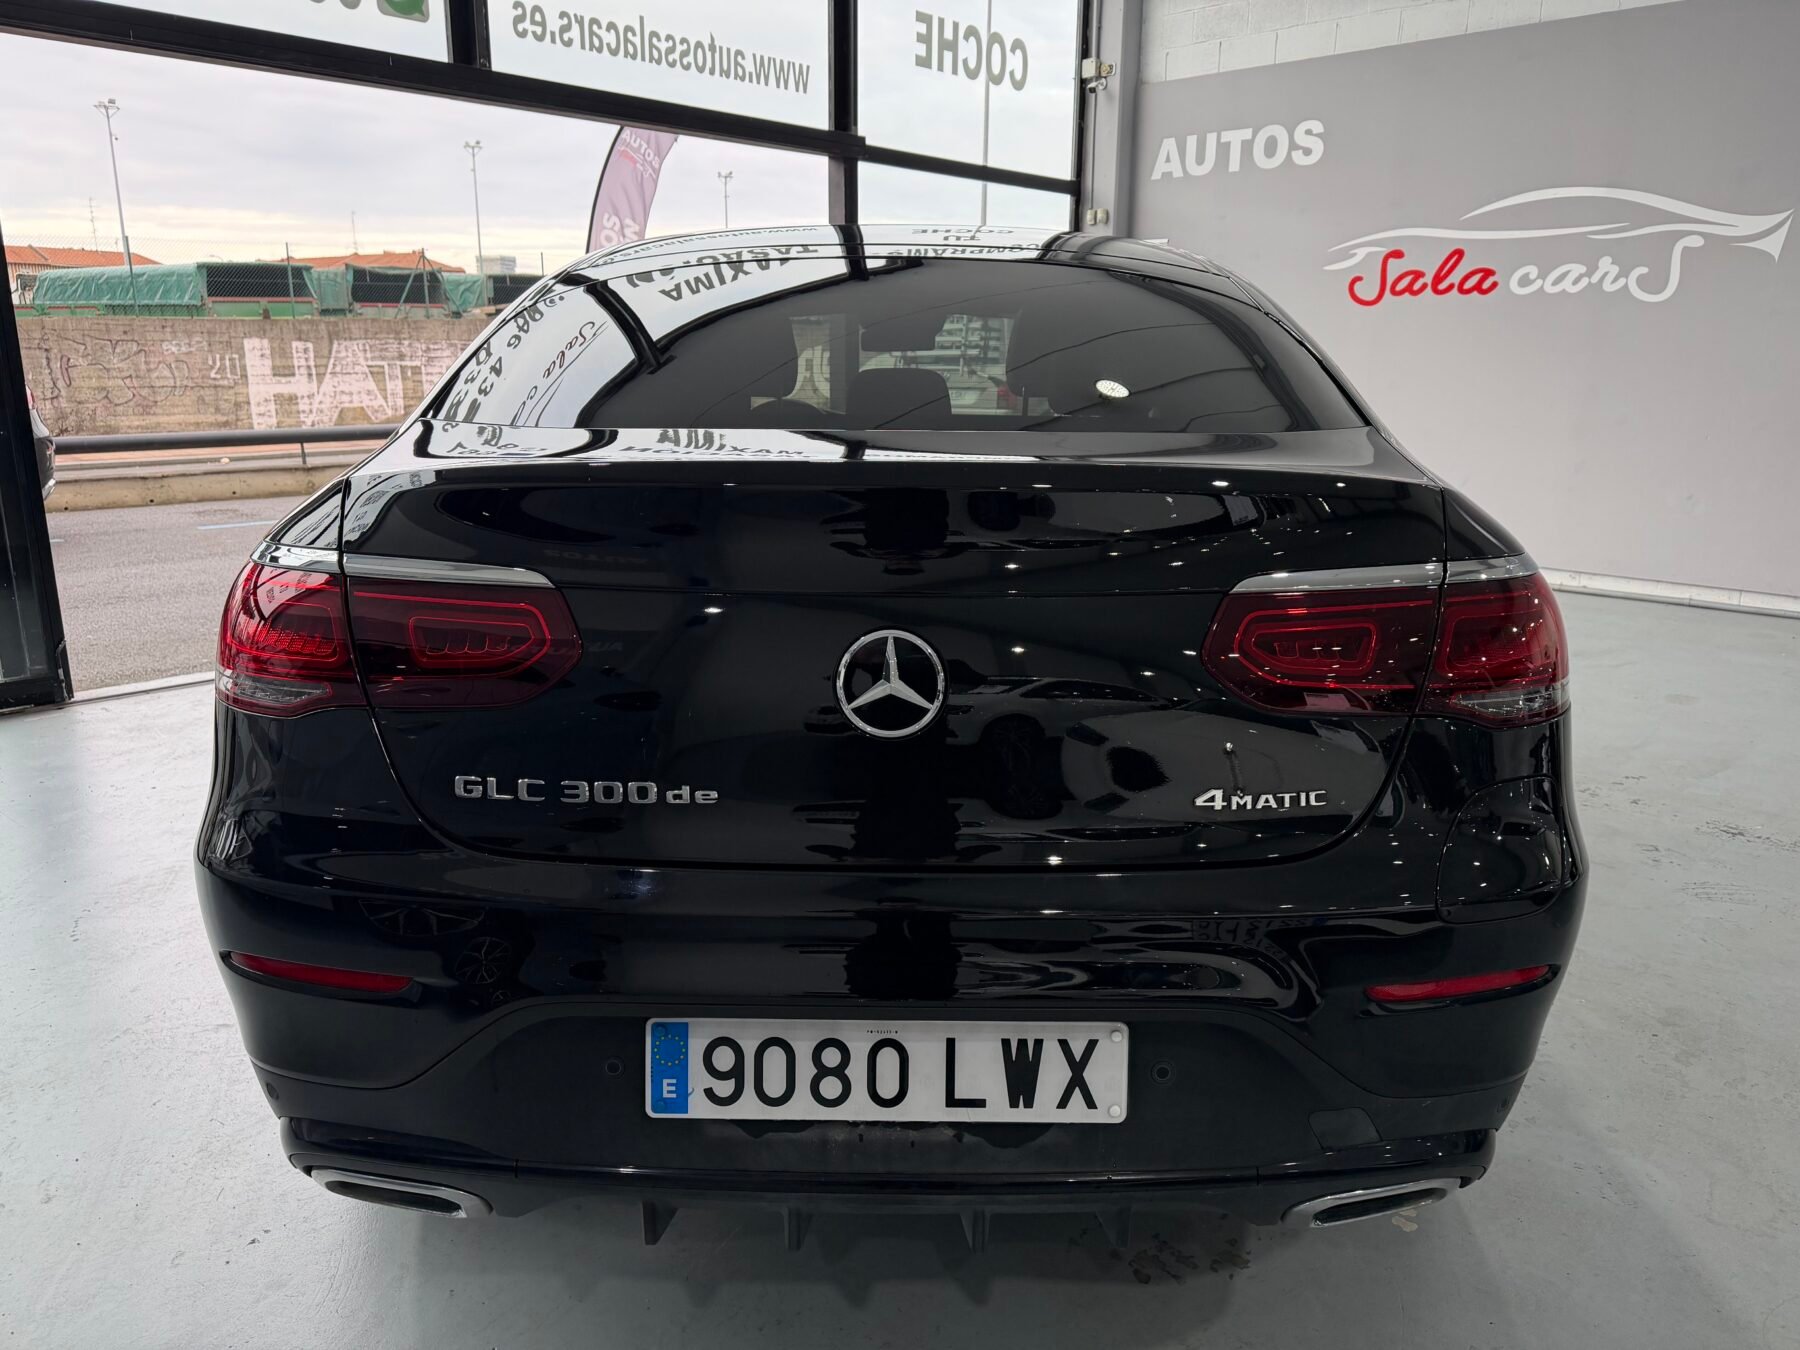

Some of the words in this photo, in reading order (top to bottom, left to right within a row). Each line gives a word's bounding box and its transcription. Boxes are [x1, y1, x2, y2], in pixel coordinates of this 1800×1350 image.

[1151, 120, 1325, 180] AUTOS
[1348, 248, 1499, 306] Sala
[454, 775, 546, 802] GLC
[560, 781, 657, 804] 300
[665, 785, 718, 804] de
[1194, 788, 1327, 811] 4MATIC
[662, 1079, 677, 1098] E
[702, 1036, 909, 1108] 9080
[945, 1037, 1099, 1109] LWX
